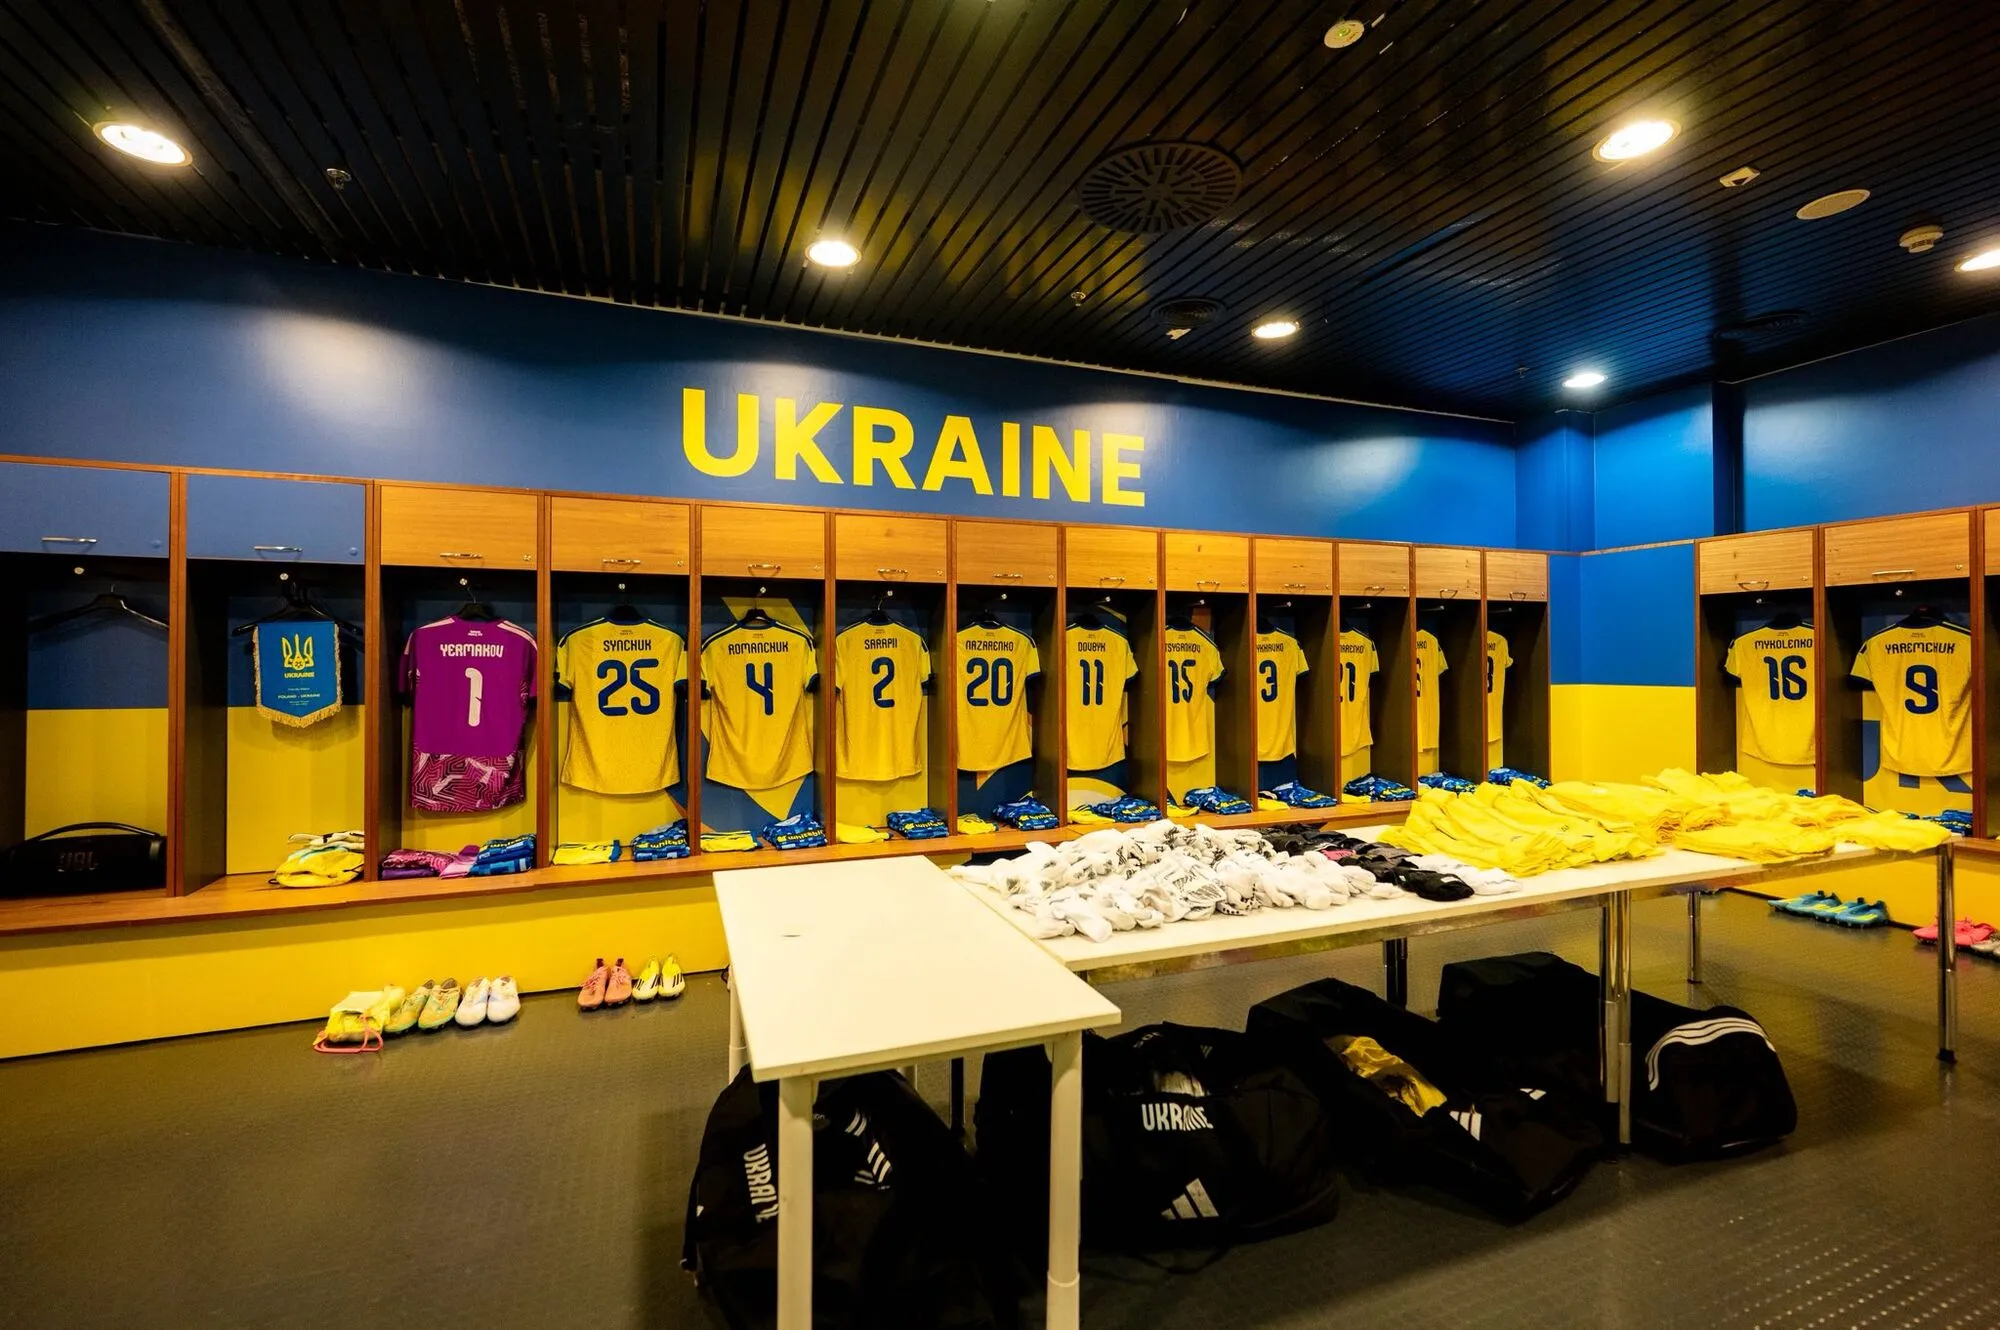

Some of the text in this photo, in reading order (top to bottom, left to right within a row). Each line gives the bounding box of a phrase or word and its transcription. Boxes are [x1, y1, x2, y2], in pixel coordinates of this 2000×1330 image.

[682, 387, 1146, 507] UKRAINE
[440, 643, 504, 658] YERMAKOV
[603, 639, 652, 652] SYNCHUK
[728, 641, 789, 655] ROMANCHUK
[864, 637, 898, 650] SARAPII
[965, 640, 1014, 652] NAZARENKO
[1078, 641, 1106, 652] DOVBYK
[1754, 638, 1813, 650] MYKOLENKO
[1885, 642, 1956, 655] YAREMCHUK
[284, 671, 315, 679] UKRAINE
[465, 667, 483, 727] 1
[597, 658, 660, 716] 25
[746, 662, 774, 716] 4
[871, 656, 896, 708] 2
[966, 657, 1014, 707] 20
[1079, 659, 1104, 706] 11
[1168, 659, 1197, 704] 15
[1259, 659, 1278, 702] 3
[1763, 655, 1807, 701] 16
[1904, 664, 1939, 715] 9
